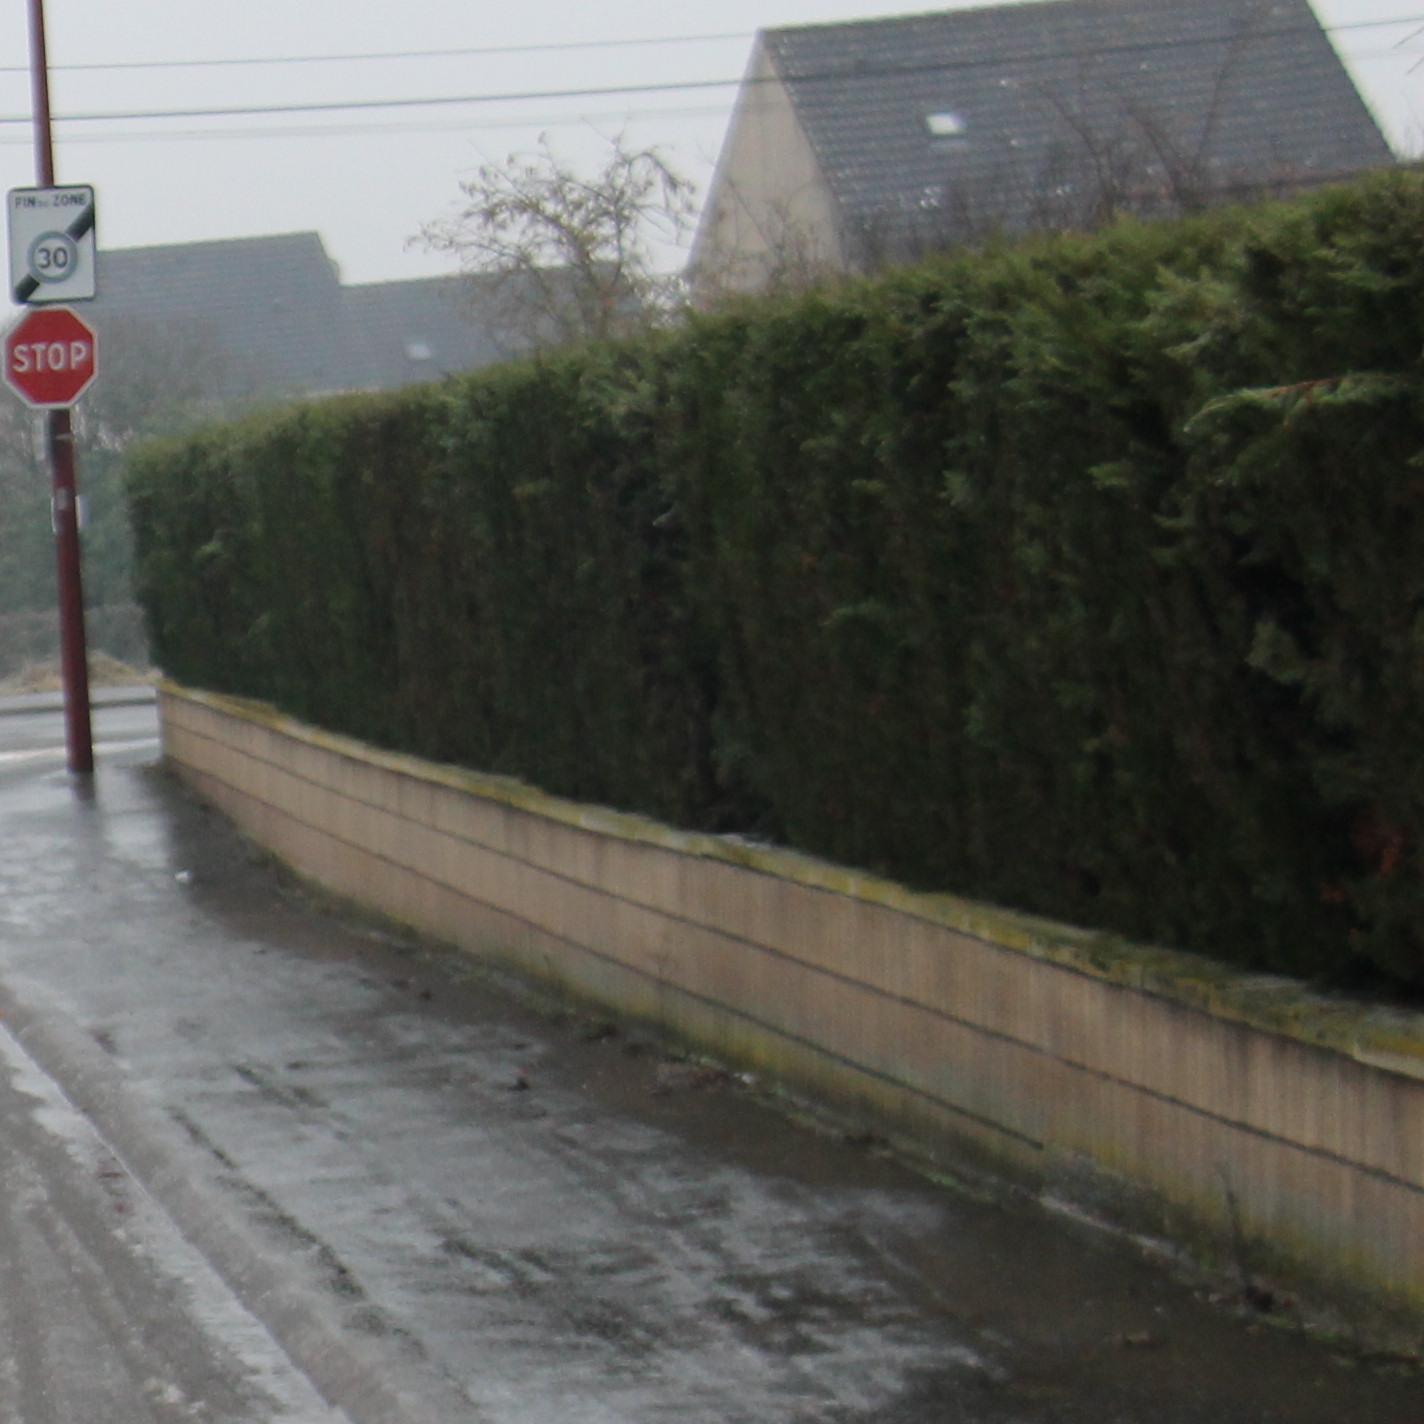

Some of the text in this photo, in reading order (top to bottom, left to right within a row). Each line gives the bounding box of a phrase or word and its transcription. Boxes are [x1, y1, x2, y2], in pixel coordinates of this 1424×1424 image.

[15, 196, 36, 209] FIN
[53, 192, 87, 207] ZONE
[37, 247, 69, 269] 30
[13, 342, 86, 372] STOP
